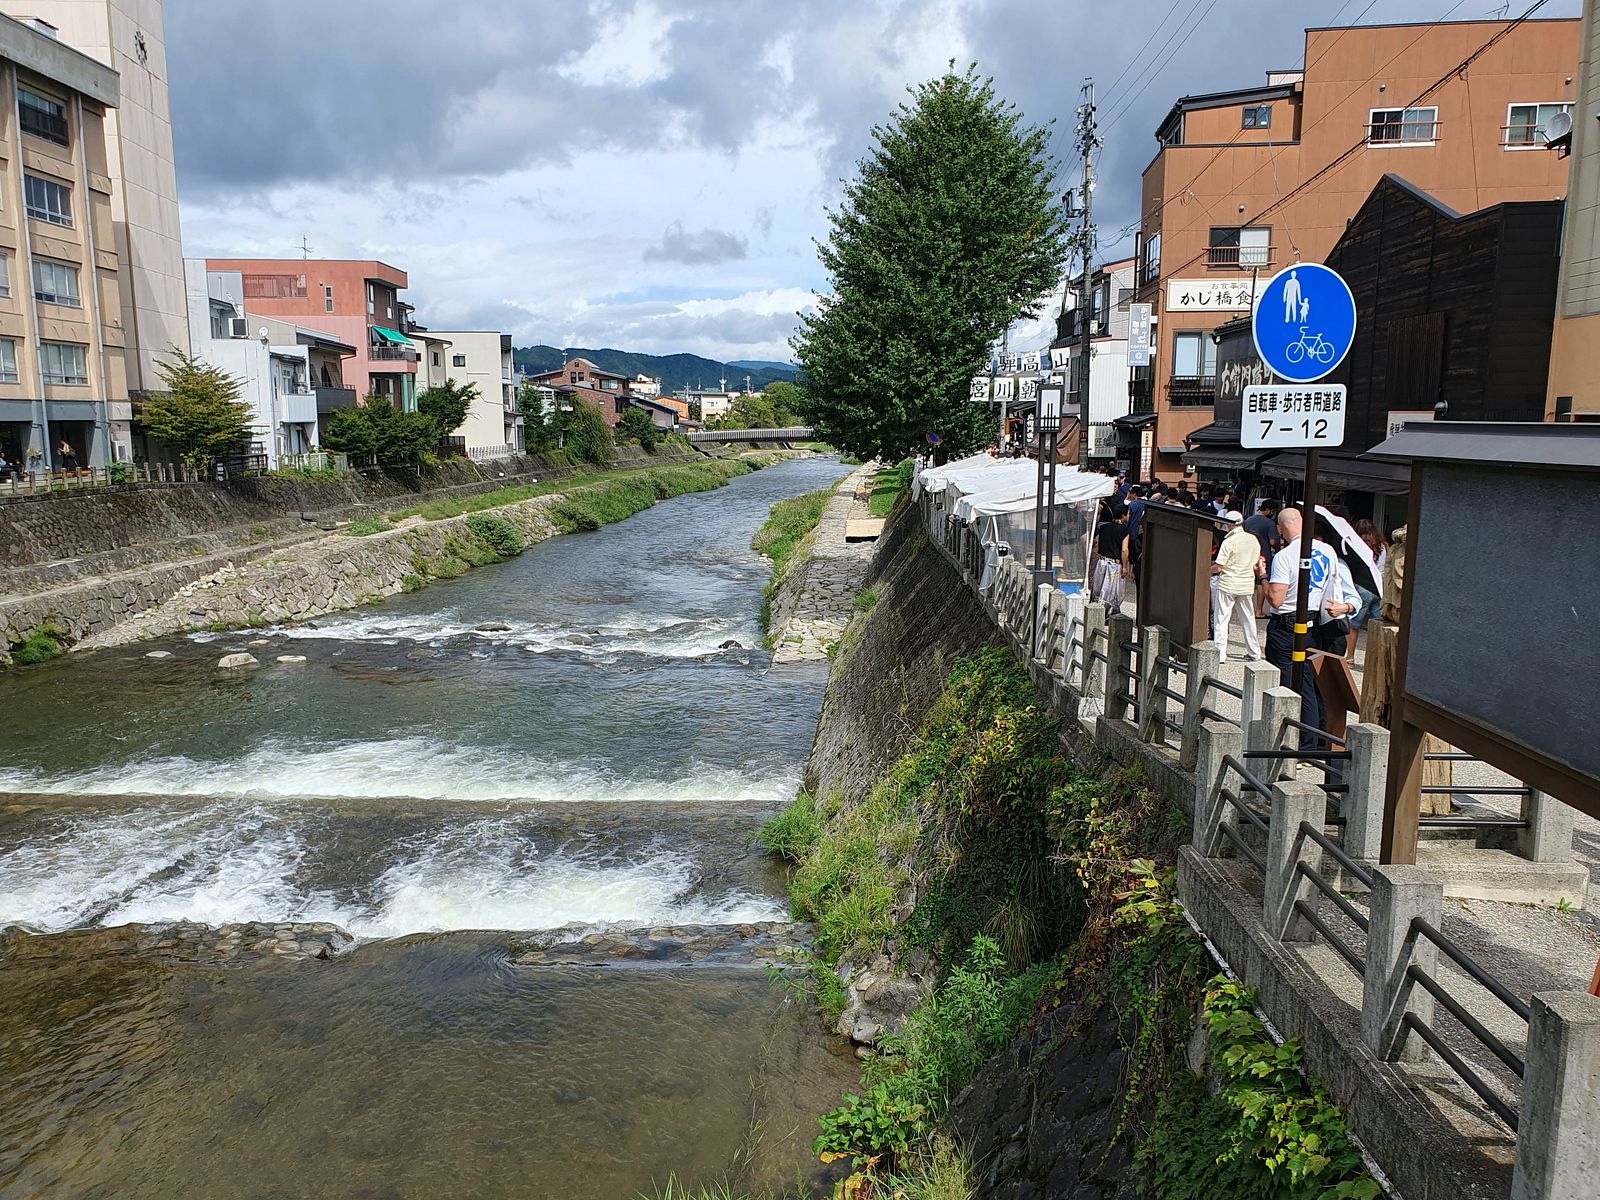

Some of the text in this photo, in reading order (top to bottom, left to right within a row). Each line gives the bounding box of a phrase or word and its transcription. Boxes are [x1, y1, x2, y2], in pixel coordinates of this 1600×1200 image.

[1180, 290, 1261, 306] かじ橋食
[970, 378, 1062, 398] 宮川朝
[1248, 391, 1342, 413] 自転車・歩行者用道路
